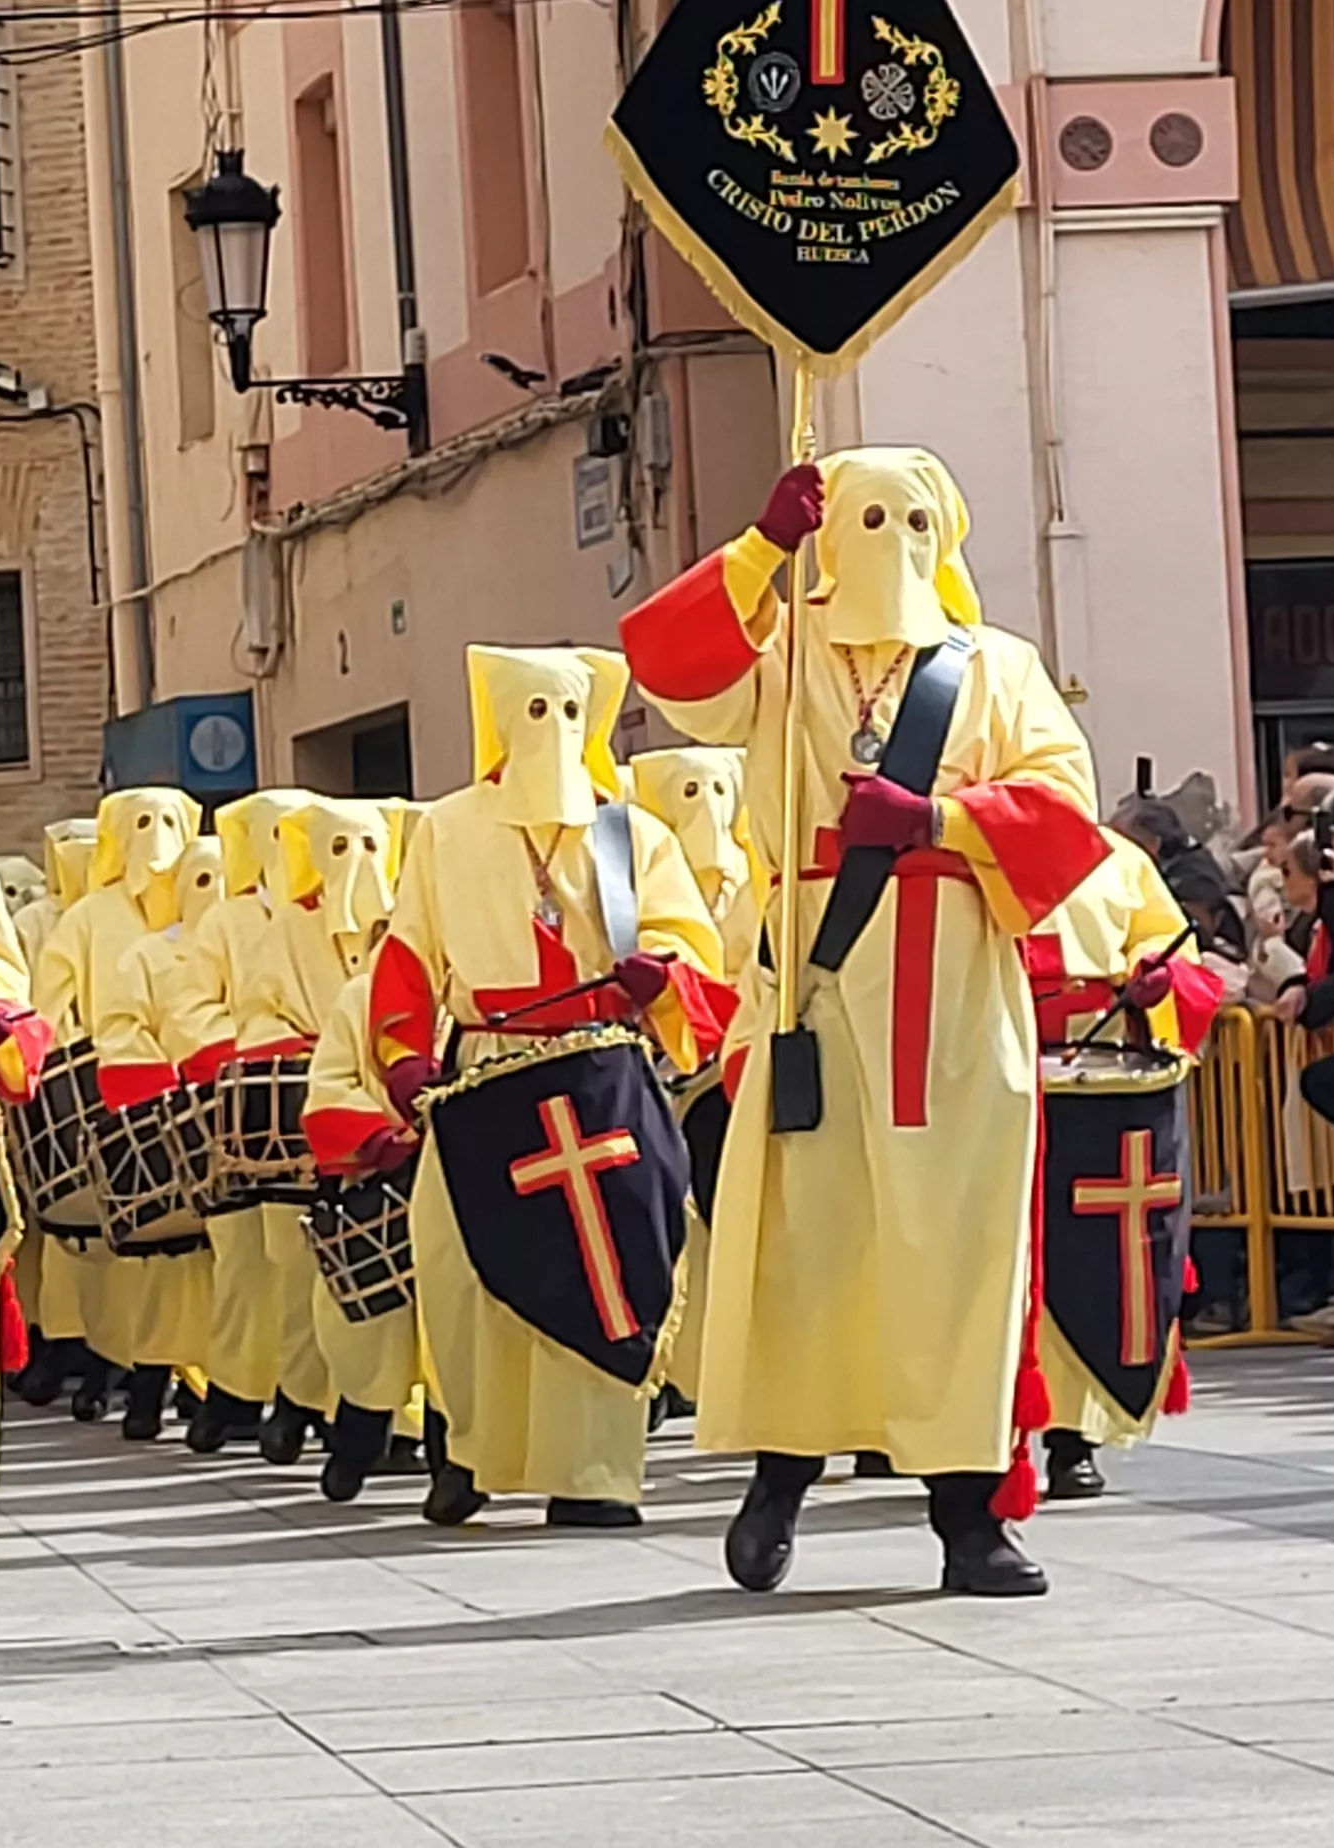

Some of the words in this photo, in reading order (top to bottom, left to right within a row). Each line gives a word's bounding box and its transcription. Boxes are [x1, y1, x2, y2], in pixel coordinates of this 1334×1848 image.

[707, 169, 793, 233] CRISTO
[797, 218, 854, 245] DEL
[857, 180, 961, 242] PERDON
[770, 188, 825, 208] Pedro
[796, 245, 871, 265] HUESCA
